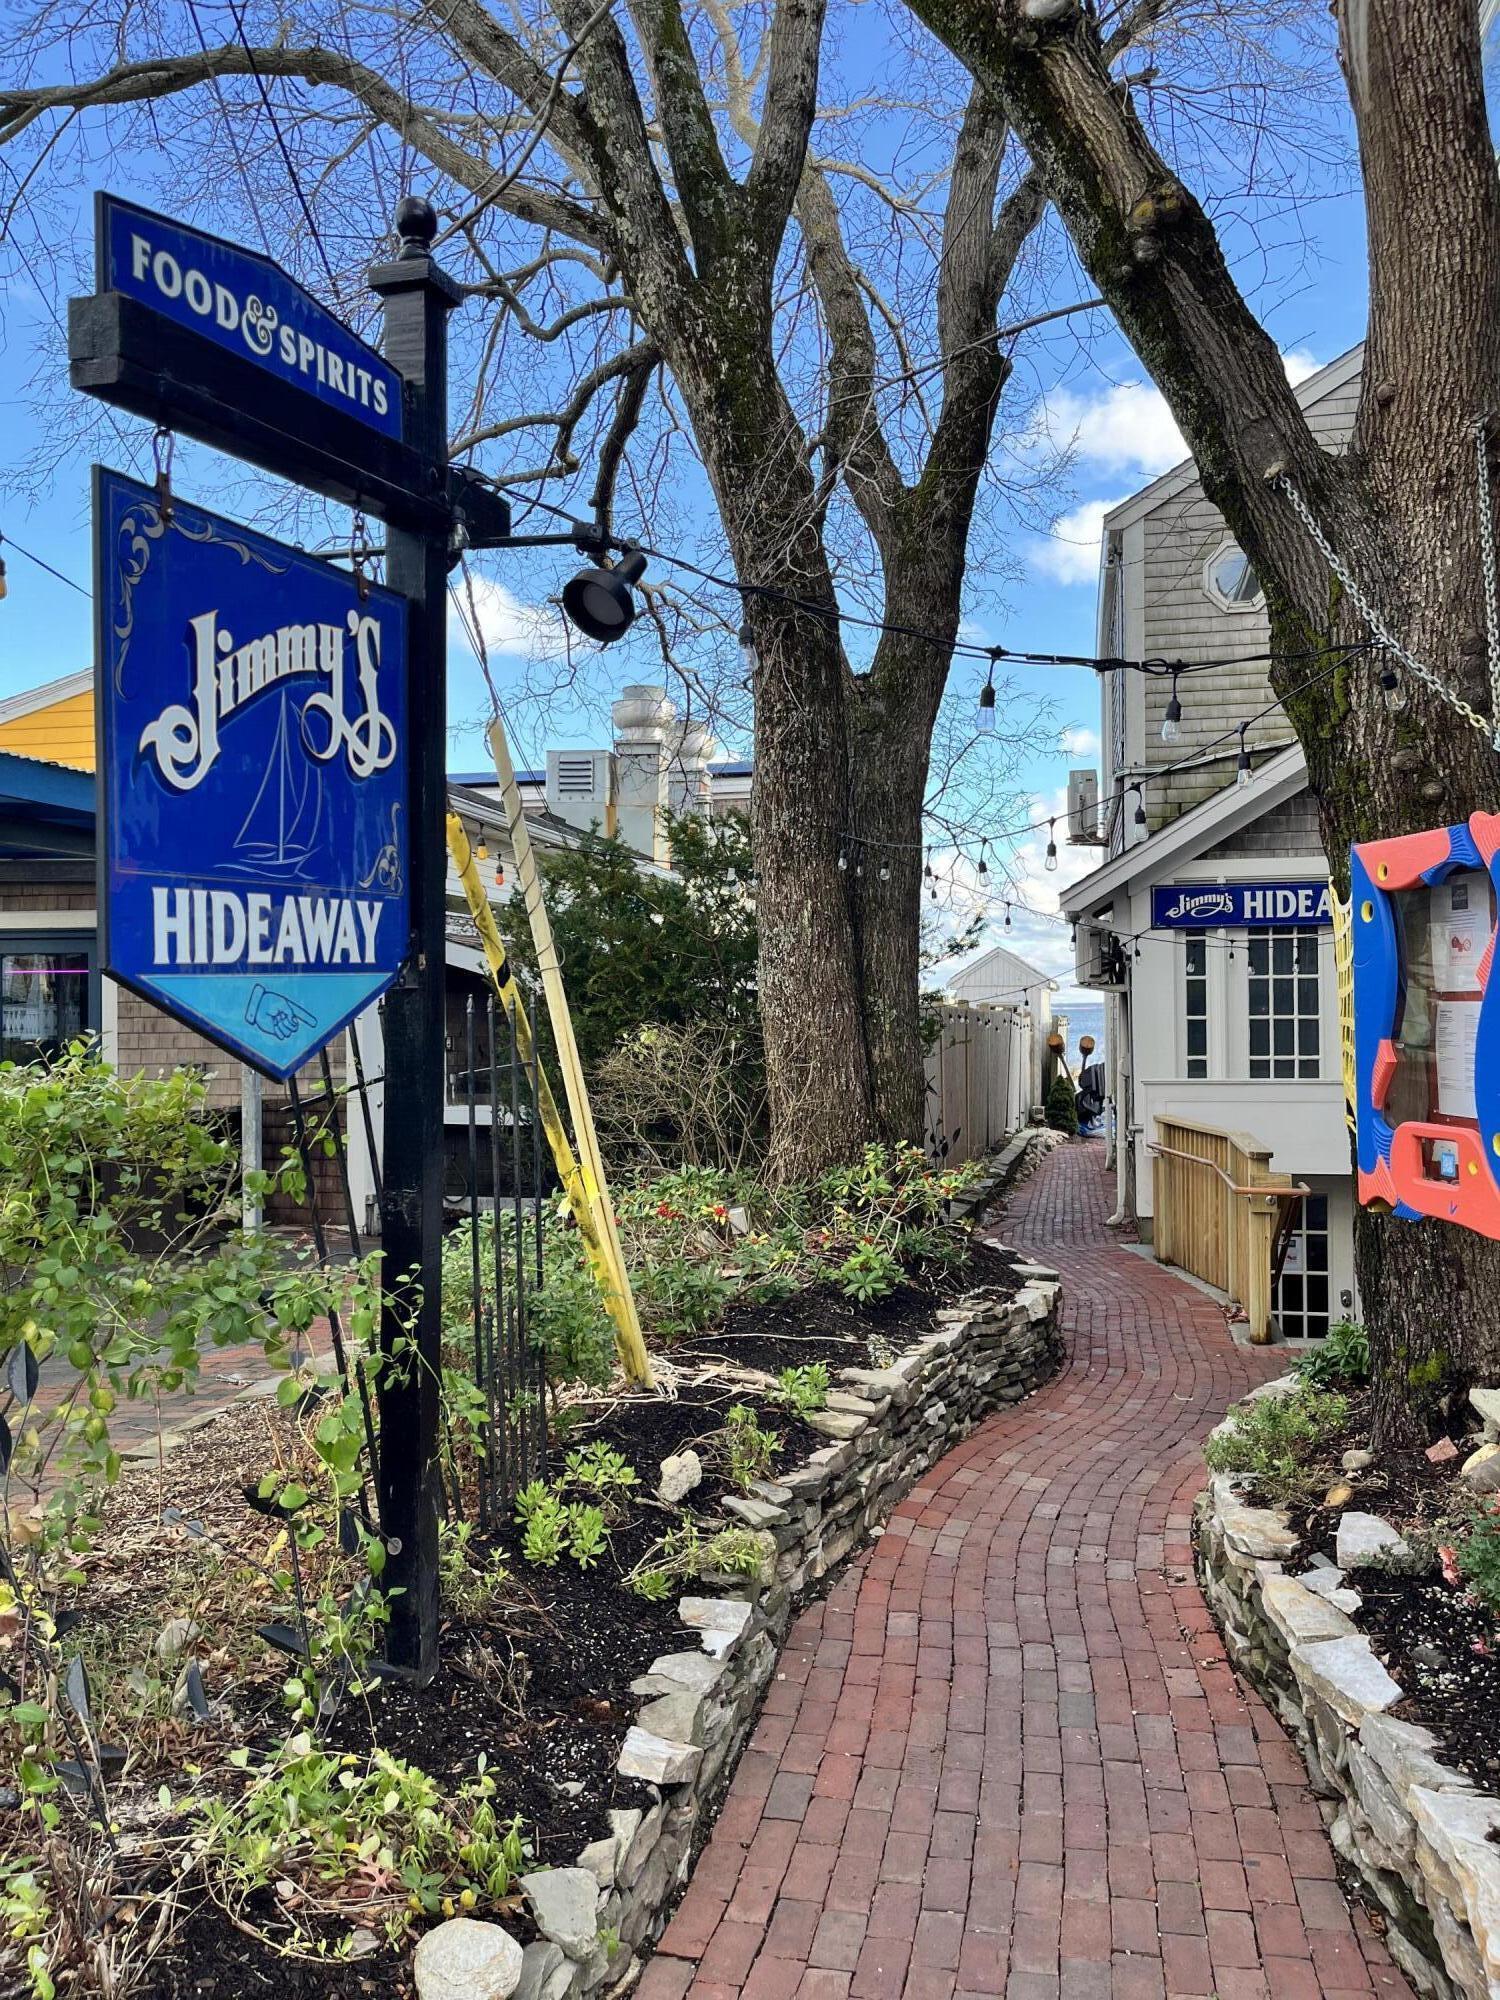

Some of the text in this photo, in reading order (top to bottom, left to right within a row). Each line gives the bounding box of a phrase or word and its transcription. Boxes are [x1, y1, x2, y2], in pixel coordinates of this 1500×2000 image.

[132, 233, 388, 416] FOOD & SPIRITS
[152, 887, 383, 966] HIDEAWAY
[1165, 889, 1333, 918] Jimmy's HIDEA
